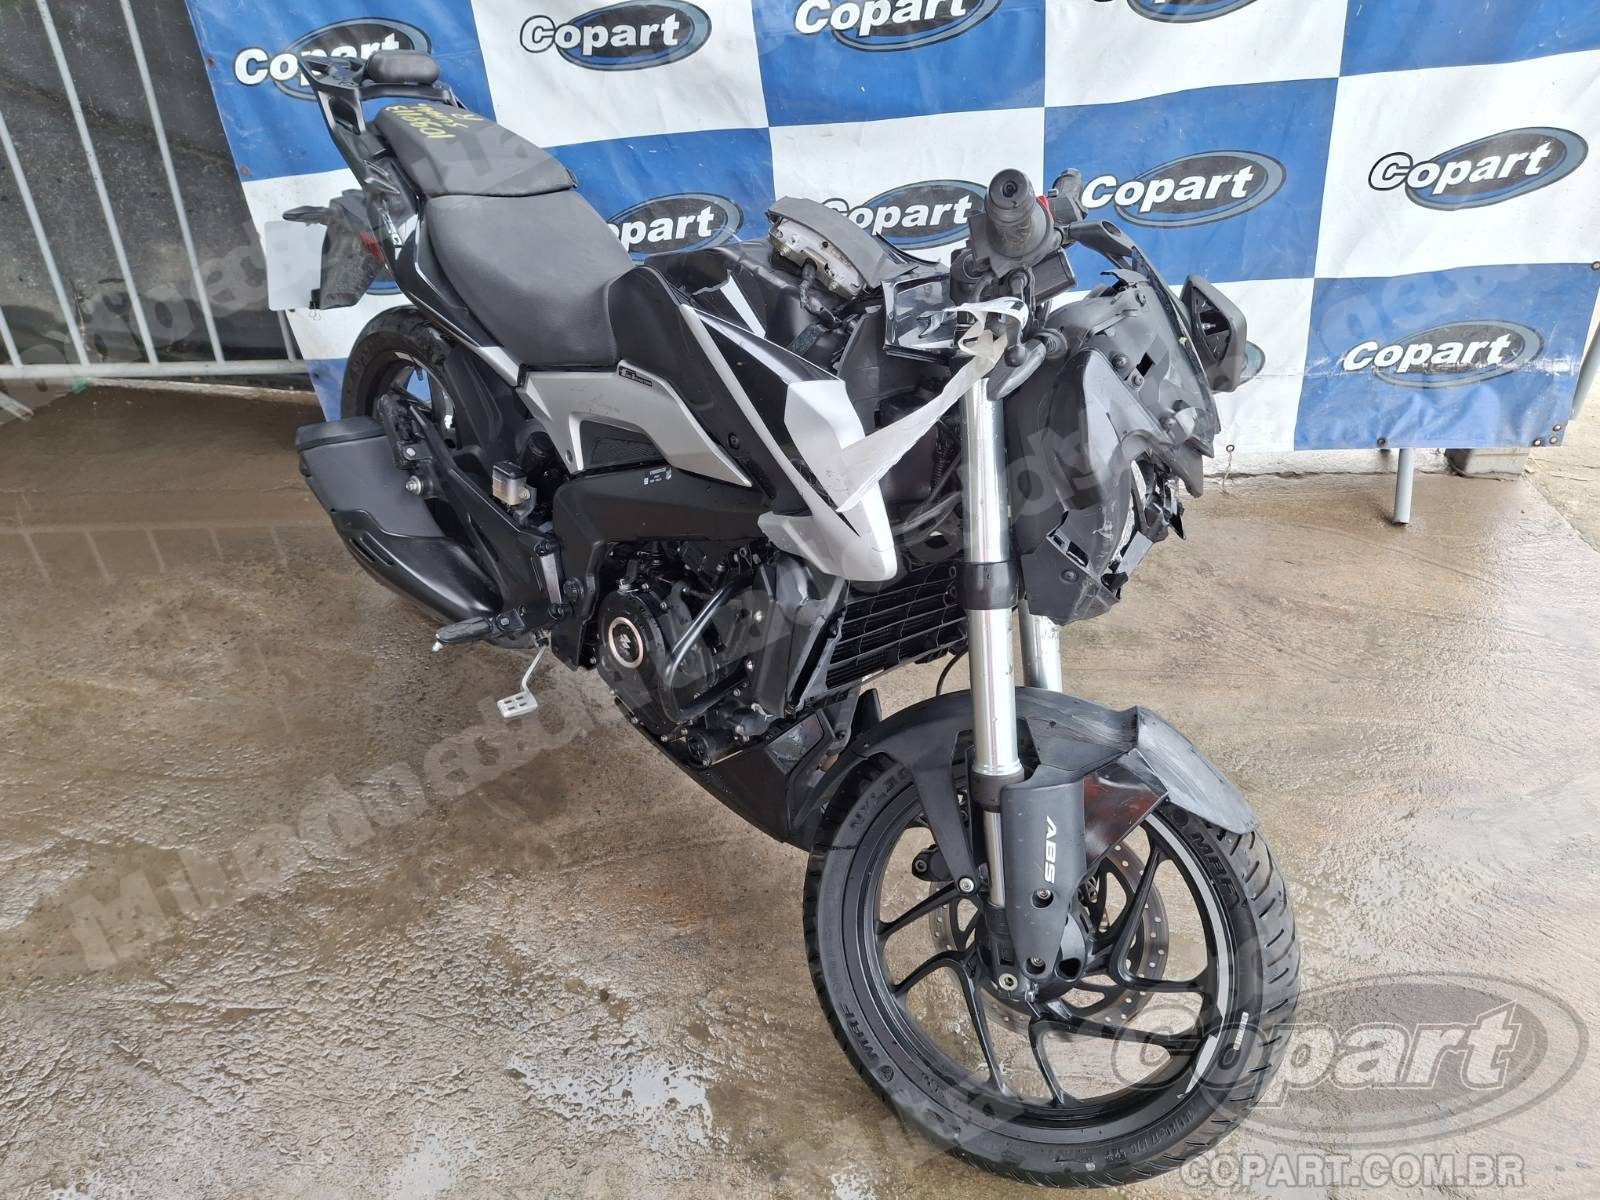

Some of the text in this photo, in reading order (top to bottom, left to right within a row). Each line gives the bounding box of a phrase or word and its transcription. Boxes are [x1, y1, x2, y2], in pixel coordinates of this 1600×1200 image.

[520, 13, 680, 56] Copart
[1081, 166, 1254, 214] Copart
[1369, 142, 1551, 195] Copart
[607, 206, 715, 252] part
[1343, 334, 1511, 373] Copart
[1044, 815, 1057, 884] ABS
